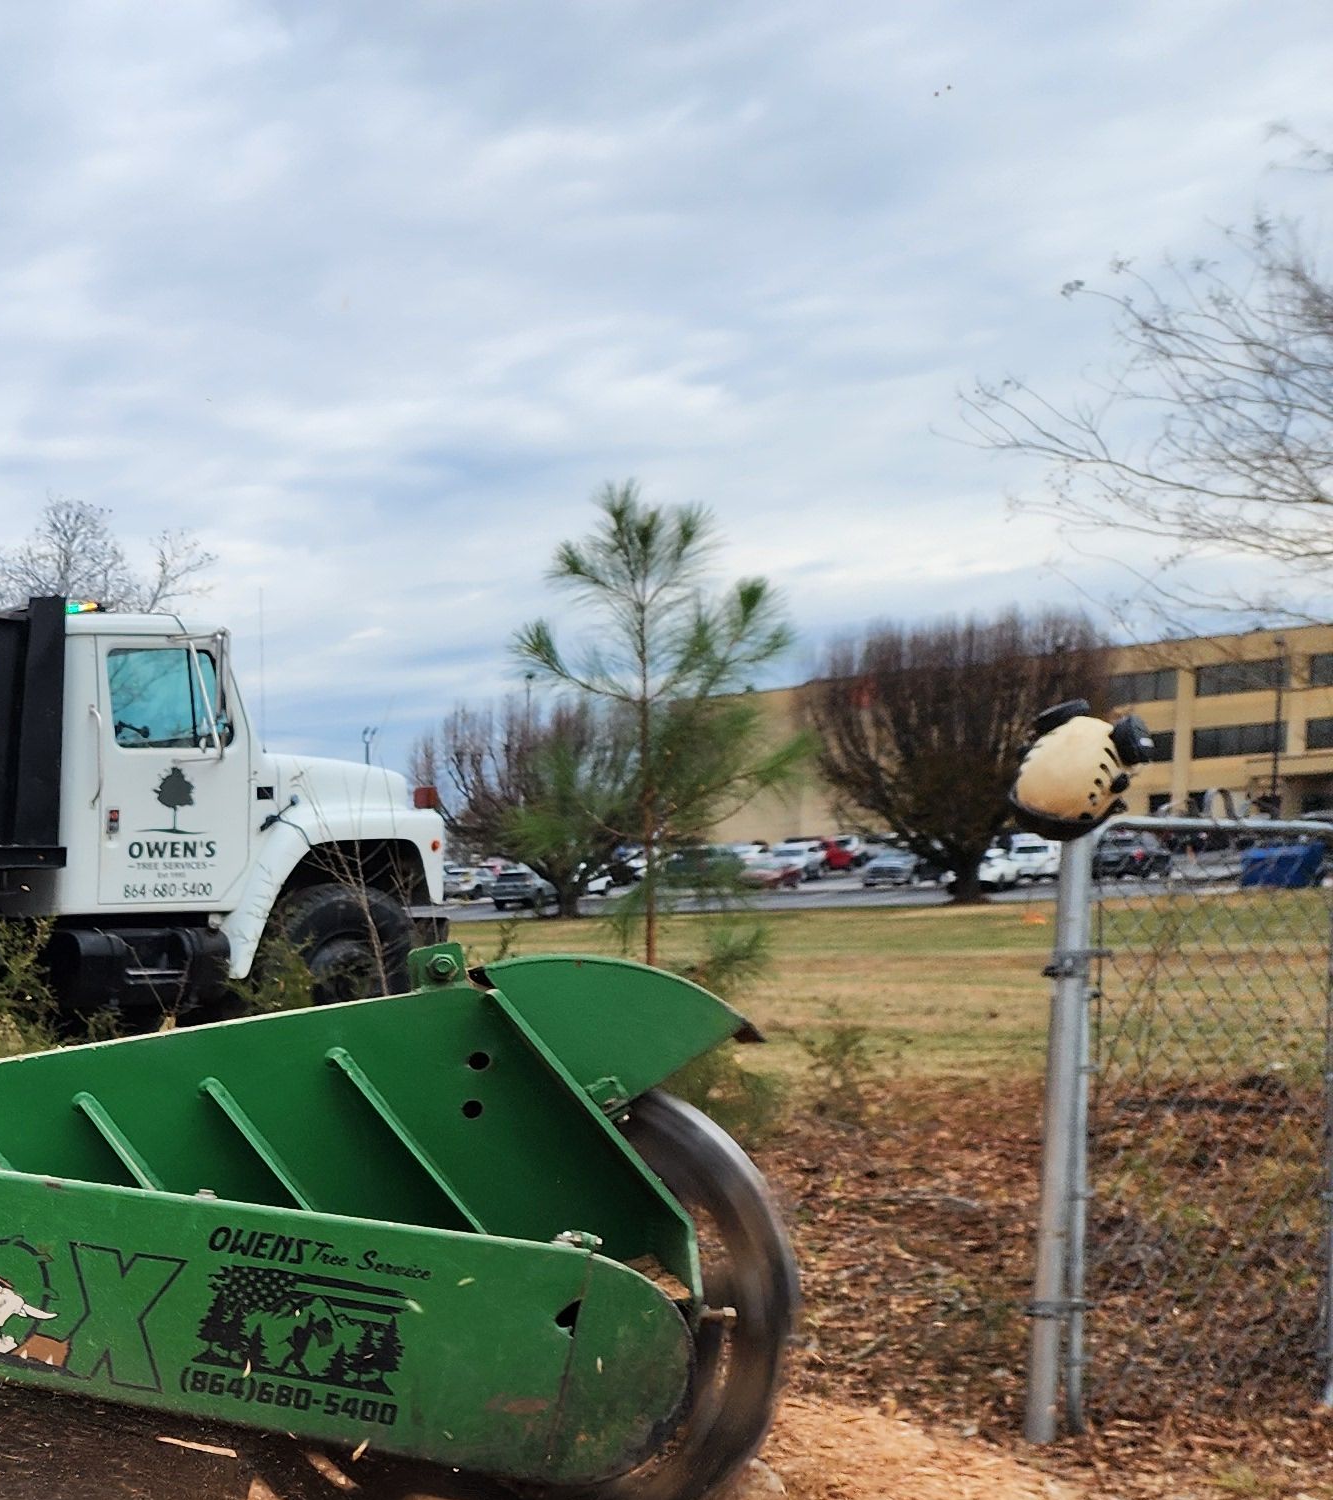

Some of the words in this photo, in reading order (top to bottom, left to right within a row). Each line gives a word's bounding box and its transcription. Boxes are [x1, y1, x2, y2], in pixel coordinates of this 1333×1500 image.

[128, 841, 217, 859] OWEN'S
[136, 862, 158, 870] TREE
[163, 861, 208, 870] SERVICES
[208, 1226, 312, 1265] OWENS
[310, 1240, 350, 1268] Tree
[356, 1248, 433, 1281] Service
[180, 1365, 399, 1426] (864)680-5400
